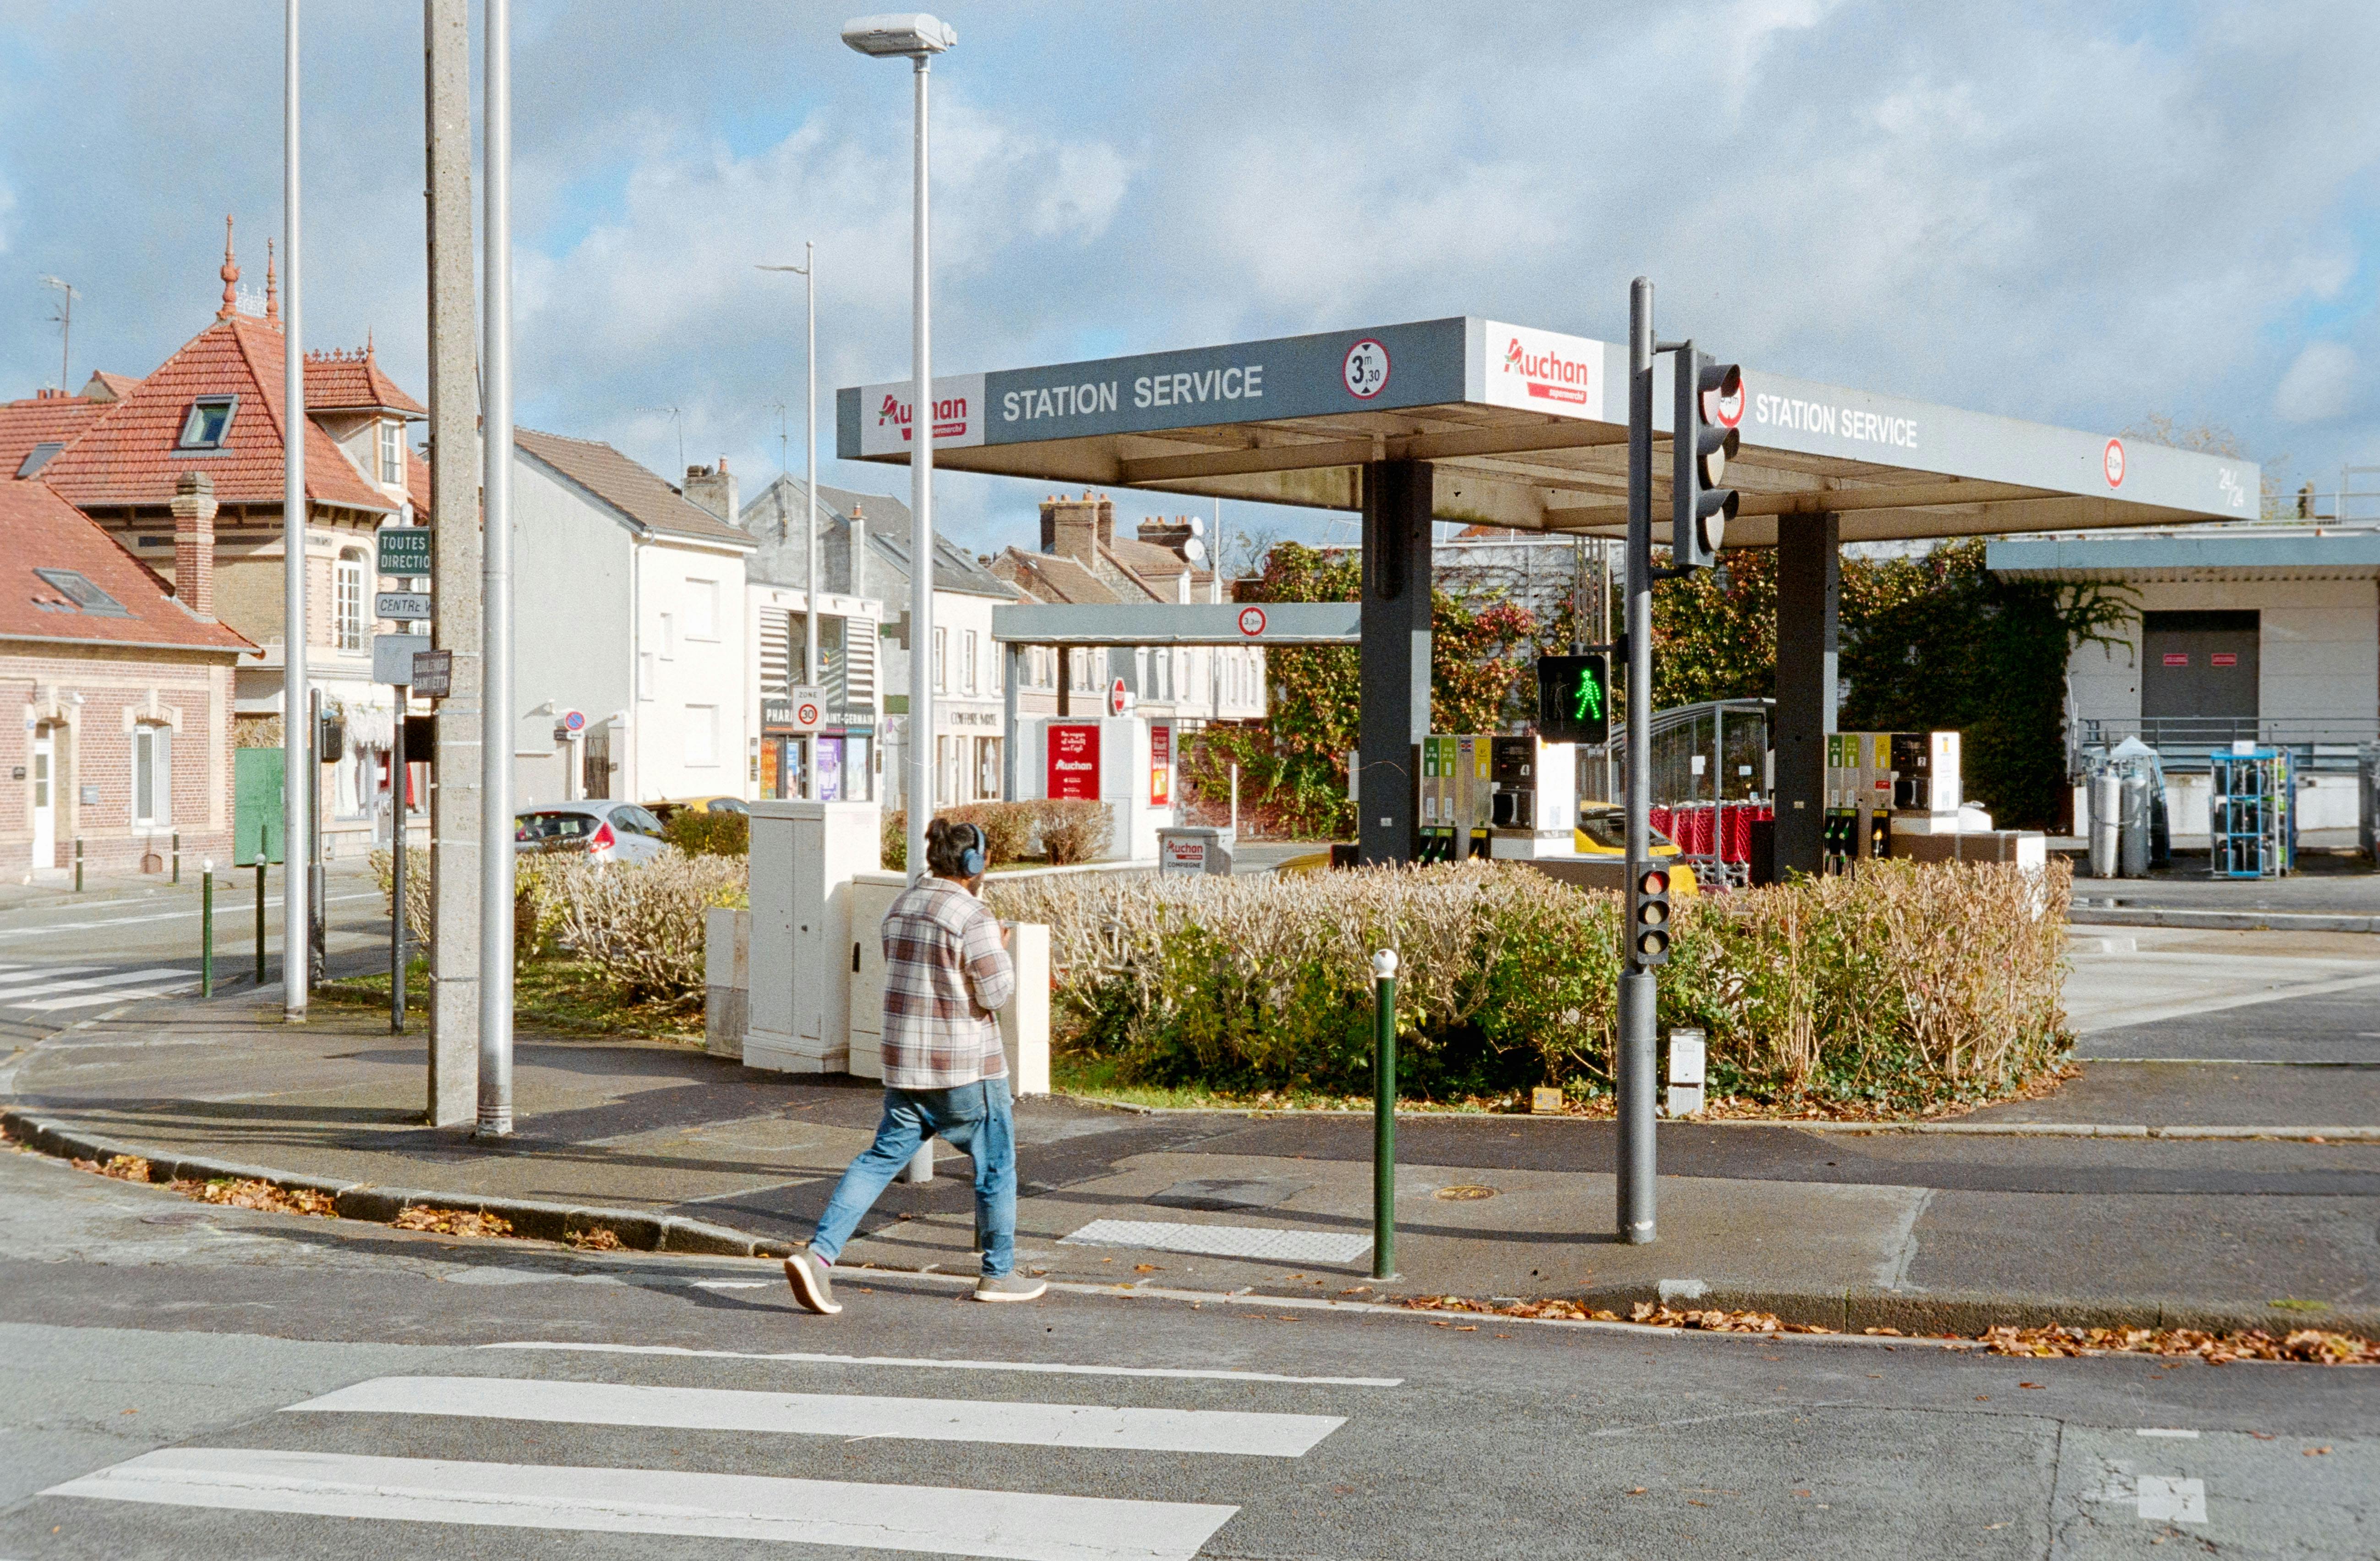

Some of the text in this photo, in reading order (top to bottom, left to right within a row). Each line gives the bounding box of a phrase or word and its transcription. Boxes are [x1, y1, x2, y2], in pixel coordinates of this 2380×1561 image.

[1504, 338, 1588, 386] Auchan
[1003, 365, 1263, 422] STATION SERVICE
[879, 394, 966, 426] Auan
[1756, 393, 1918, 449] STATION SERVICE
[382, 536, 426, 550] TOUTES
[382, 555, 430, 568] DIRECTIO
[381, 598, 420, 612] CENTRE
[802, 709, 814, 719] 30
[825, 713, 874, 725] AINT-GERMAIN
[1055, 759, 1092, 771] Auchan
[1166, 840, 1203, 853] Auchan
